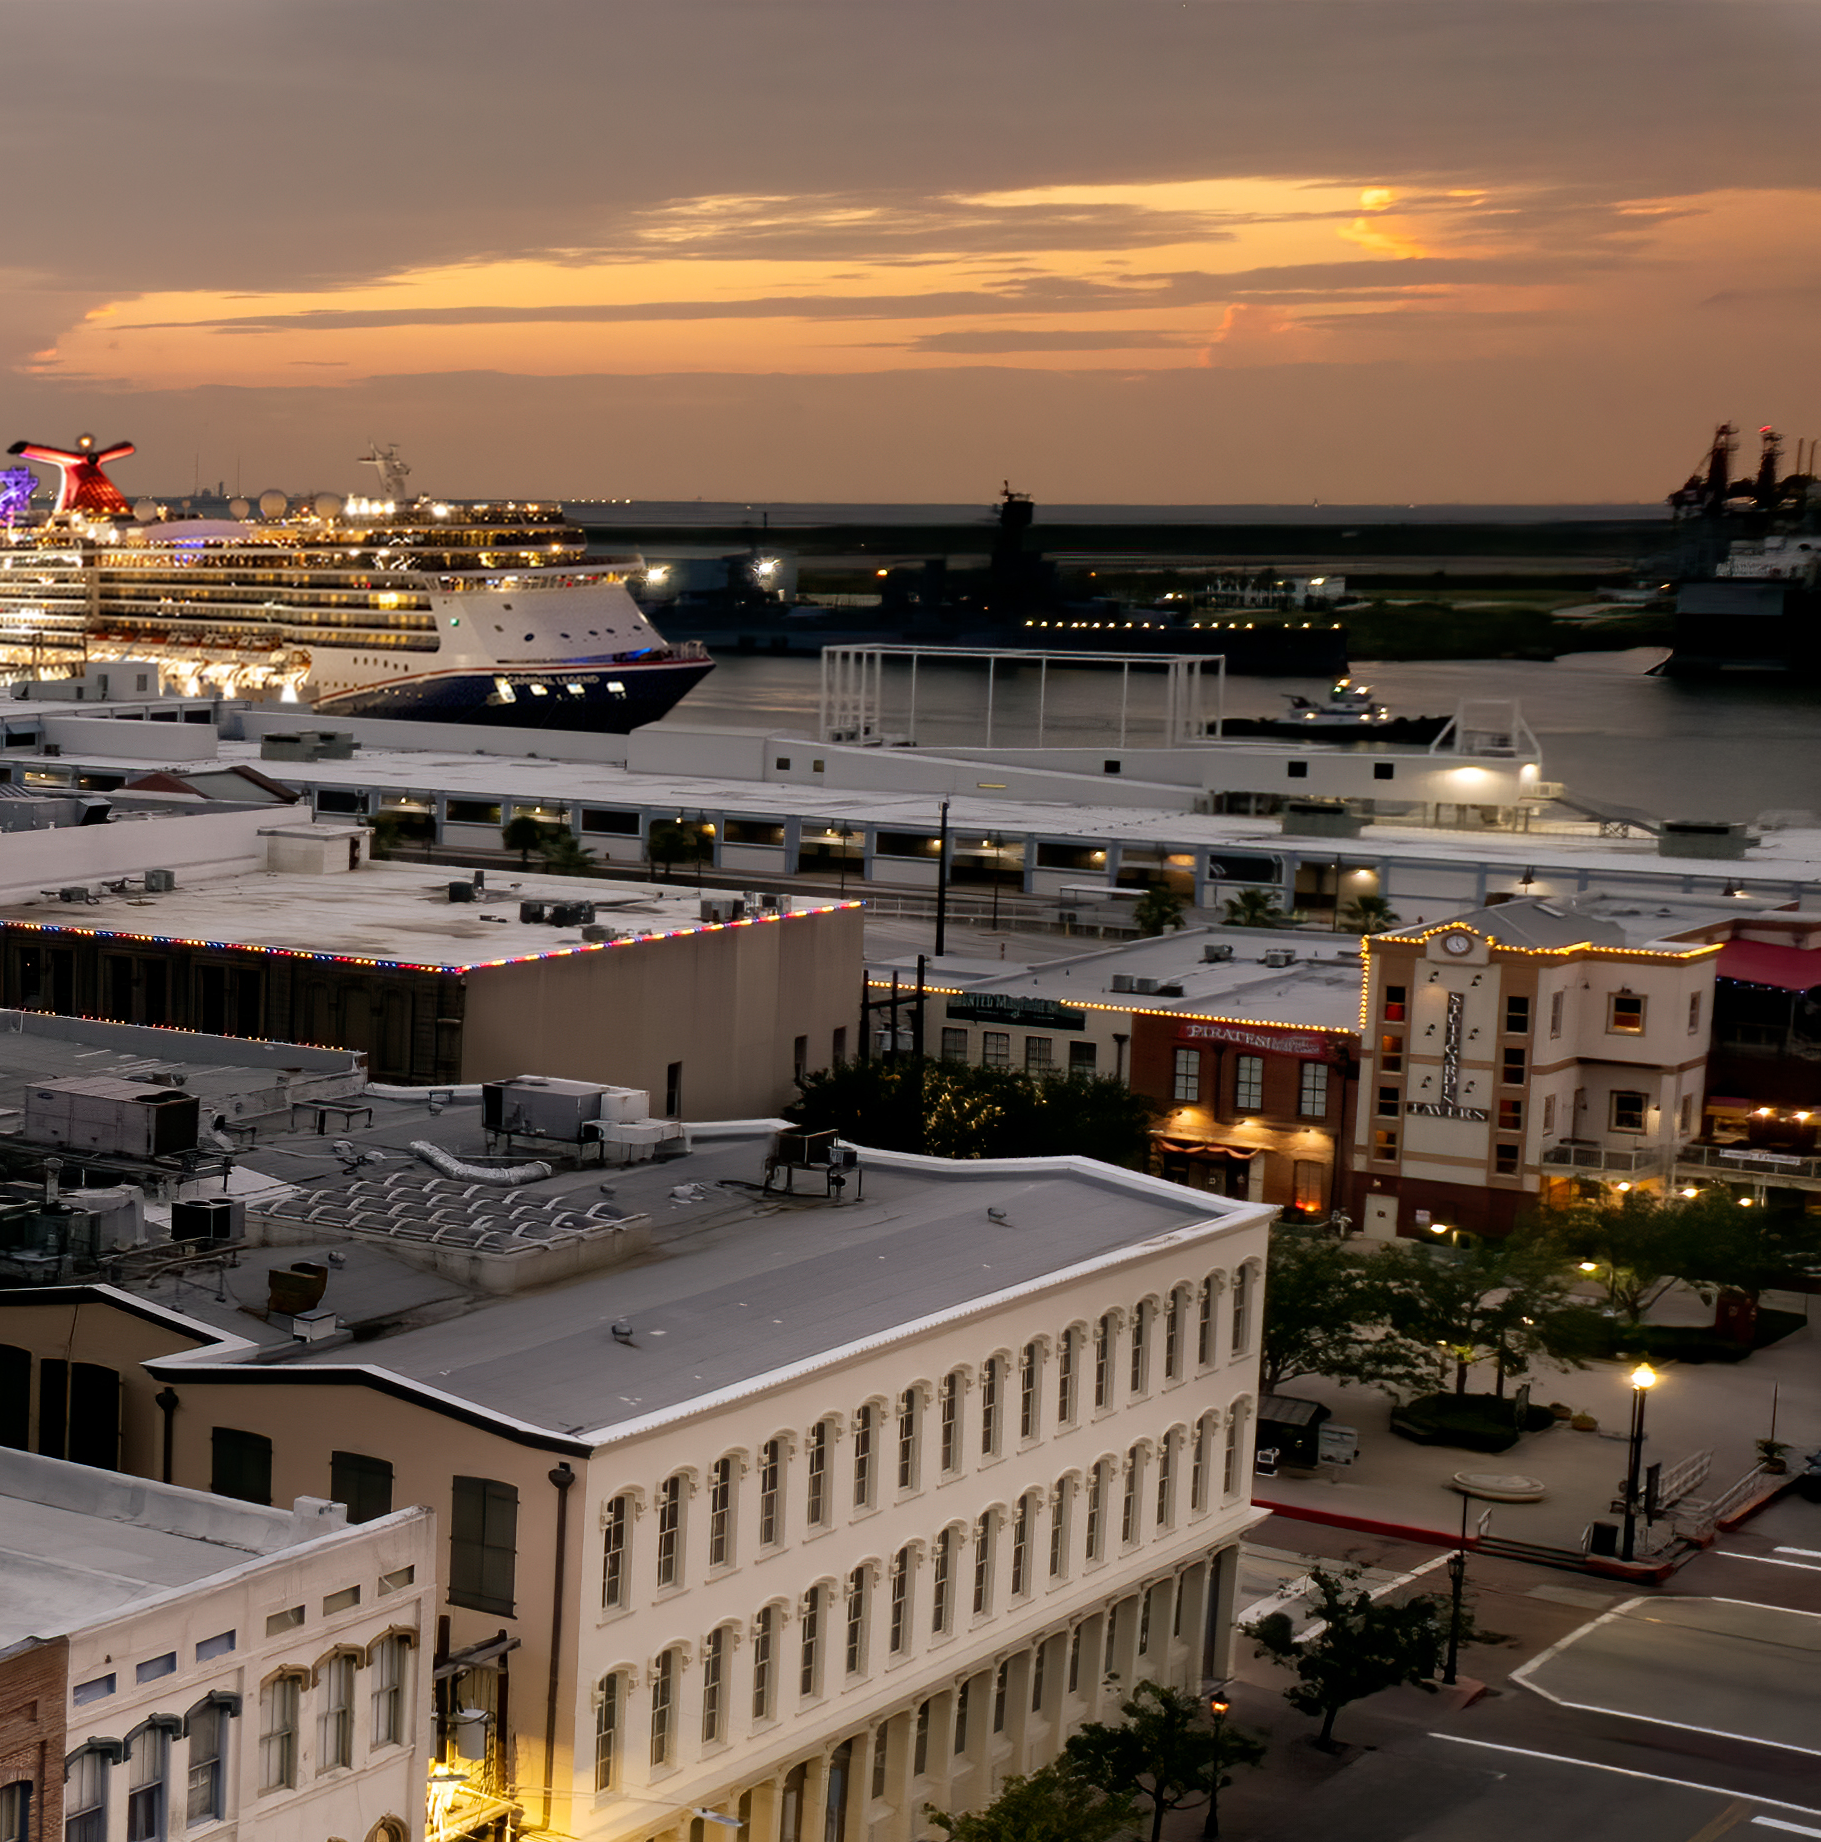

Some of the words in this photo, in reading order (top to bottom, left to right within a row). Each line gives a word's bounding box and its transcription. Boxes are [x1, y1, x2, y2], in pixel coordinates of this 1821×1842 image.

[506, 675, 555, 685] CARNIVAL
[557, 674, 601, 685] LEGEND
[1409, 1102, 1486, 1120] TAVERN
